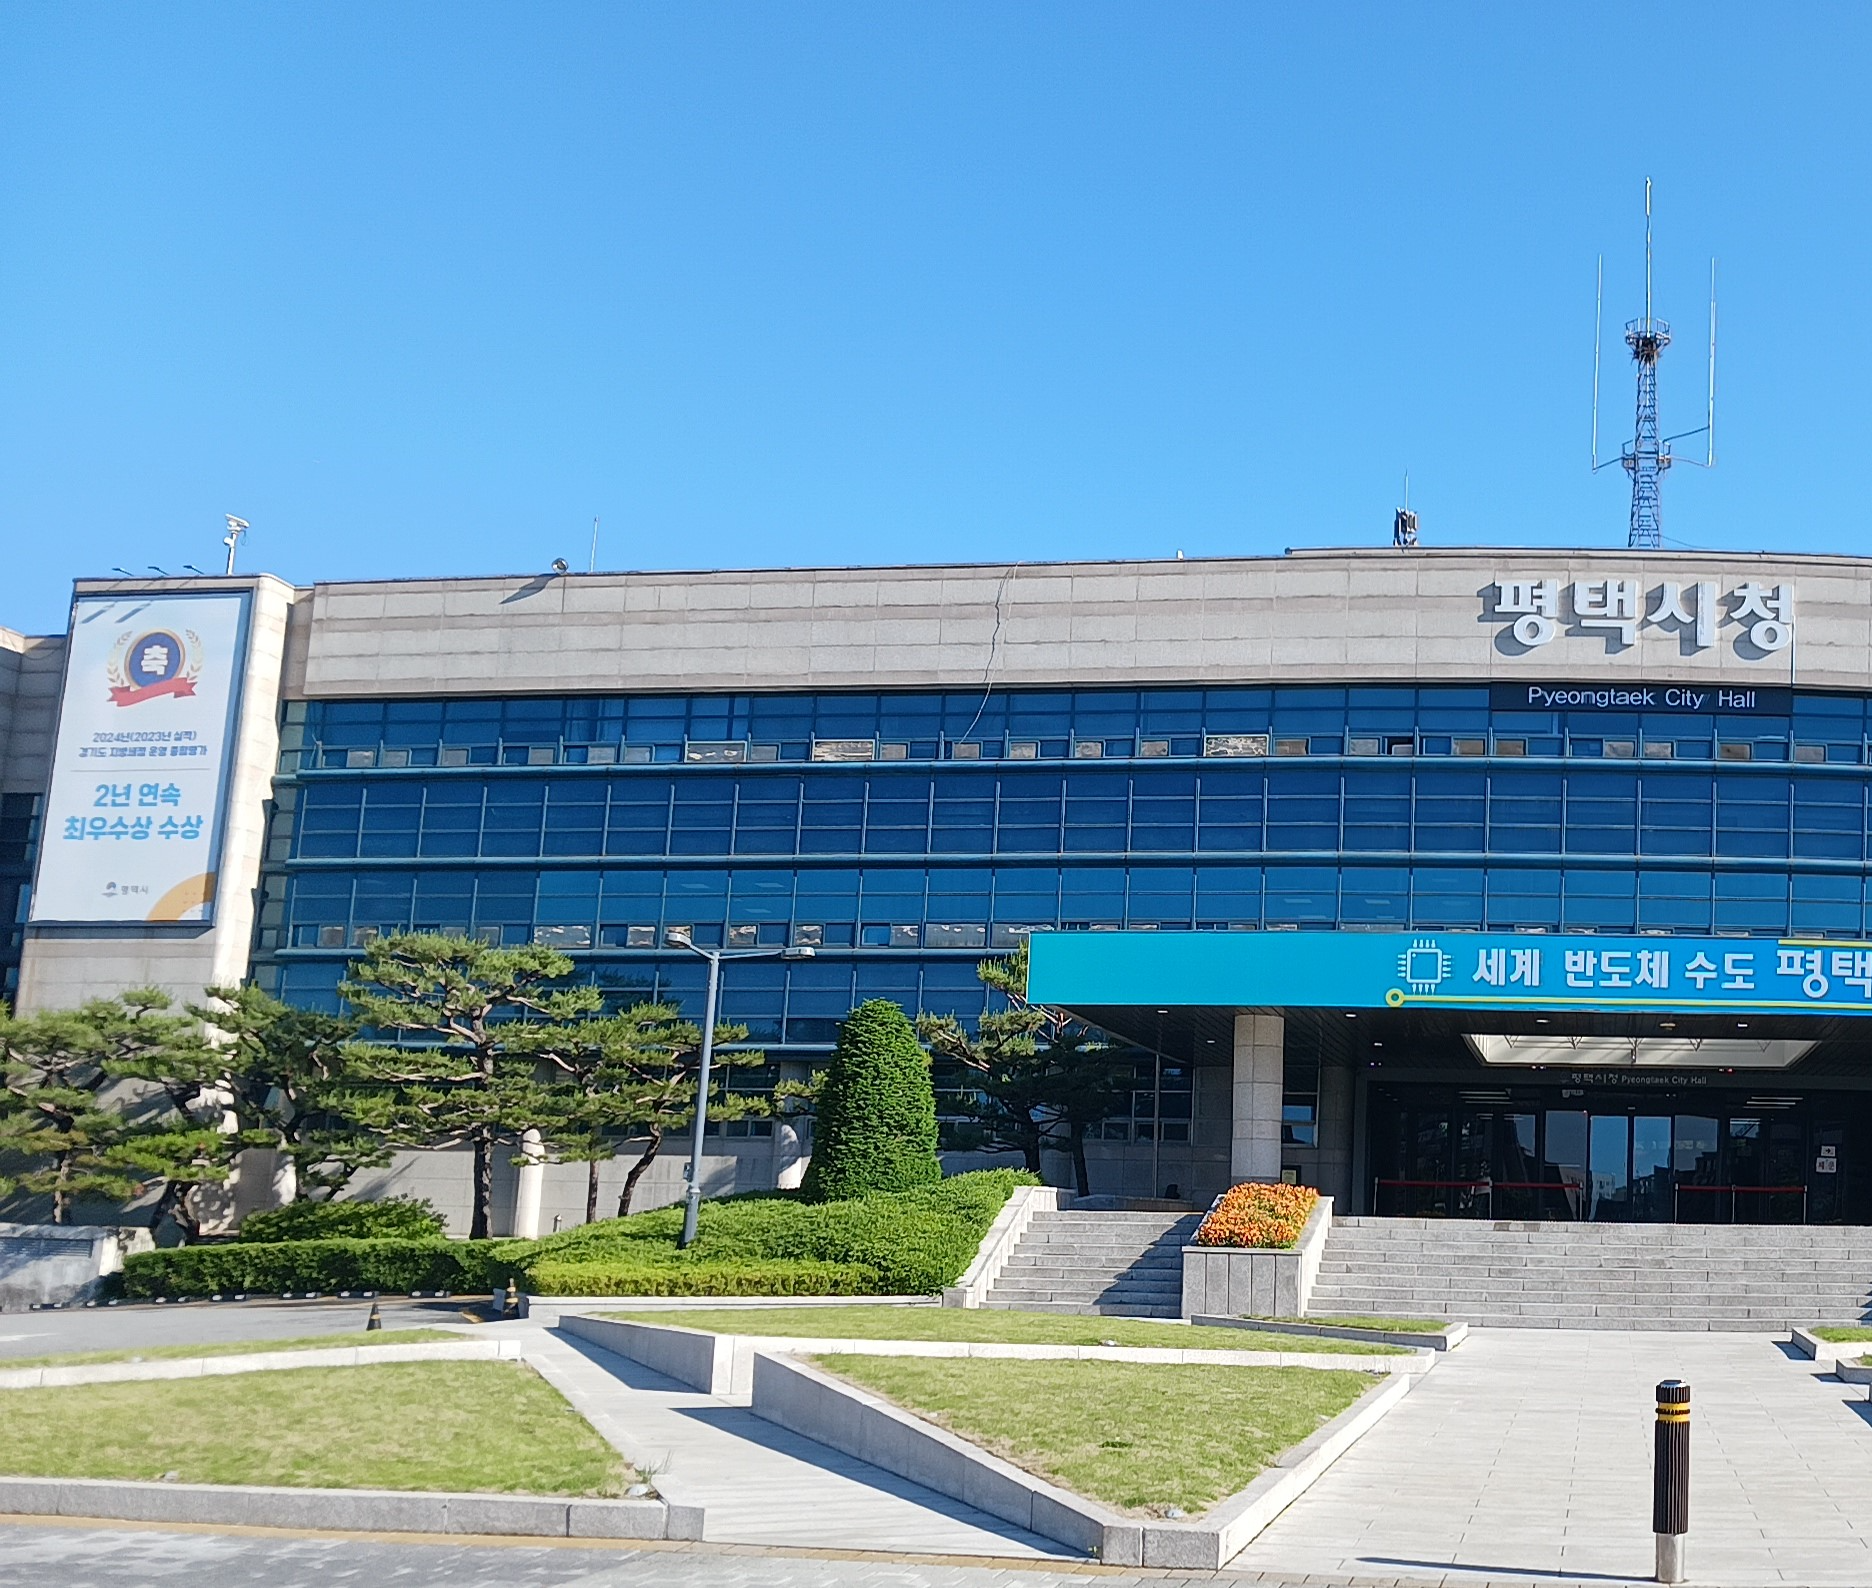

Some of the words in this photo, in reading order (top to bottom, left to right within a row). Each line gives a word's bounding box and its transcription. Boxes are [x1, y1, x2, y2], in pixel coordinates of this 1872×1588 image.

[1494, 578, 1794, 651] 평택시청
[141, 645, 168, 675] 축
[1528, 686, 1656, 707] Pyeongtaek
[1665, 688, 1705, 709] City
[1718, 690, 1756, 708] Hall
[93, 783, 132, 807] 2년
[138, 782, 181, 807] 연속
[62, 815, 153, 841] 최우수상
[157, 814, 204, 840] 수상
[1471, 948, 1542, 987] 세계
[1565, 949, 1669, 989] 반도체
[1684, 950, 1756, 990] 수도
[1571, 1073, 1619, 1085] 평택시청
[1621, 1075, 1669, 1086] Pyeongtaek
[1671, 1075, 1688, 1086] City
[1690, 1076, 1707, 1085] Hall
